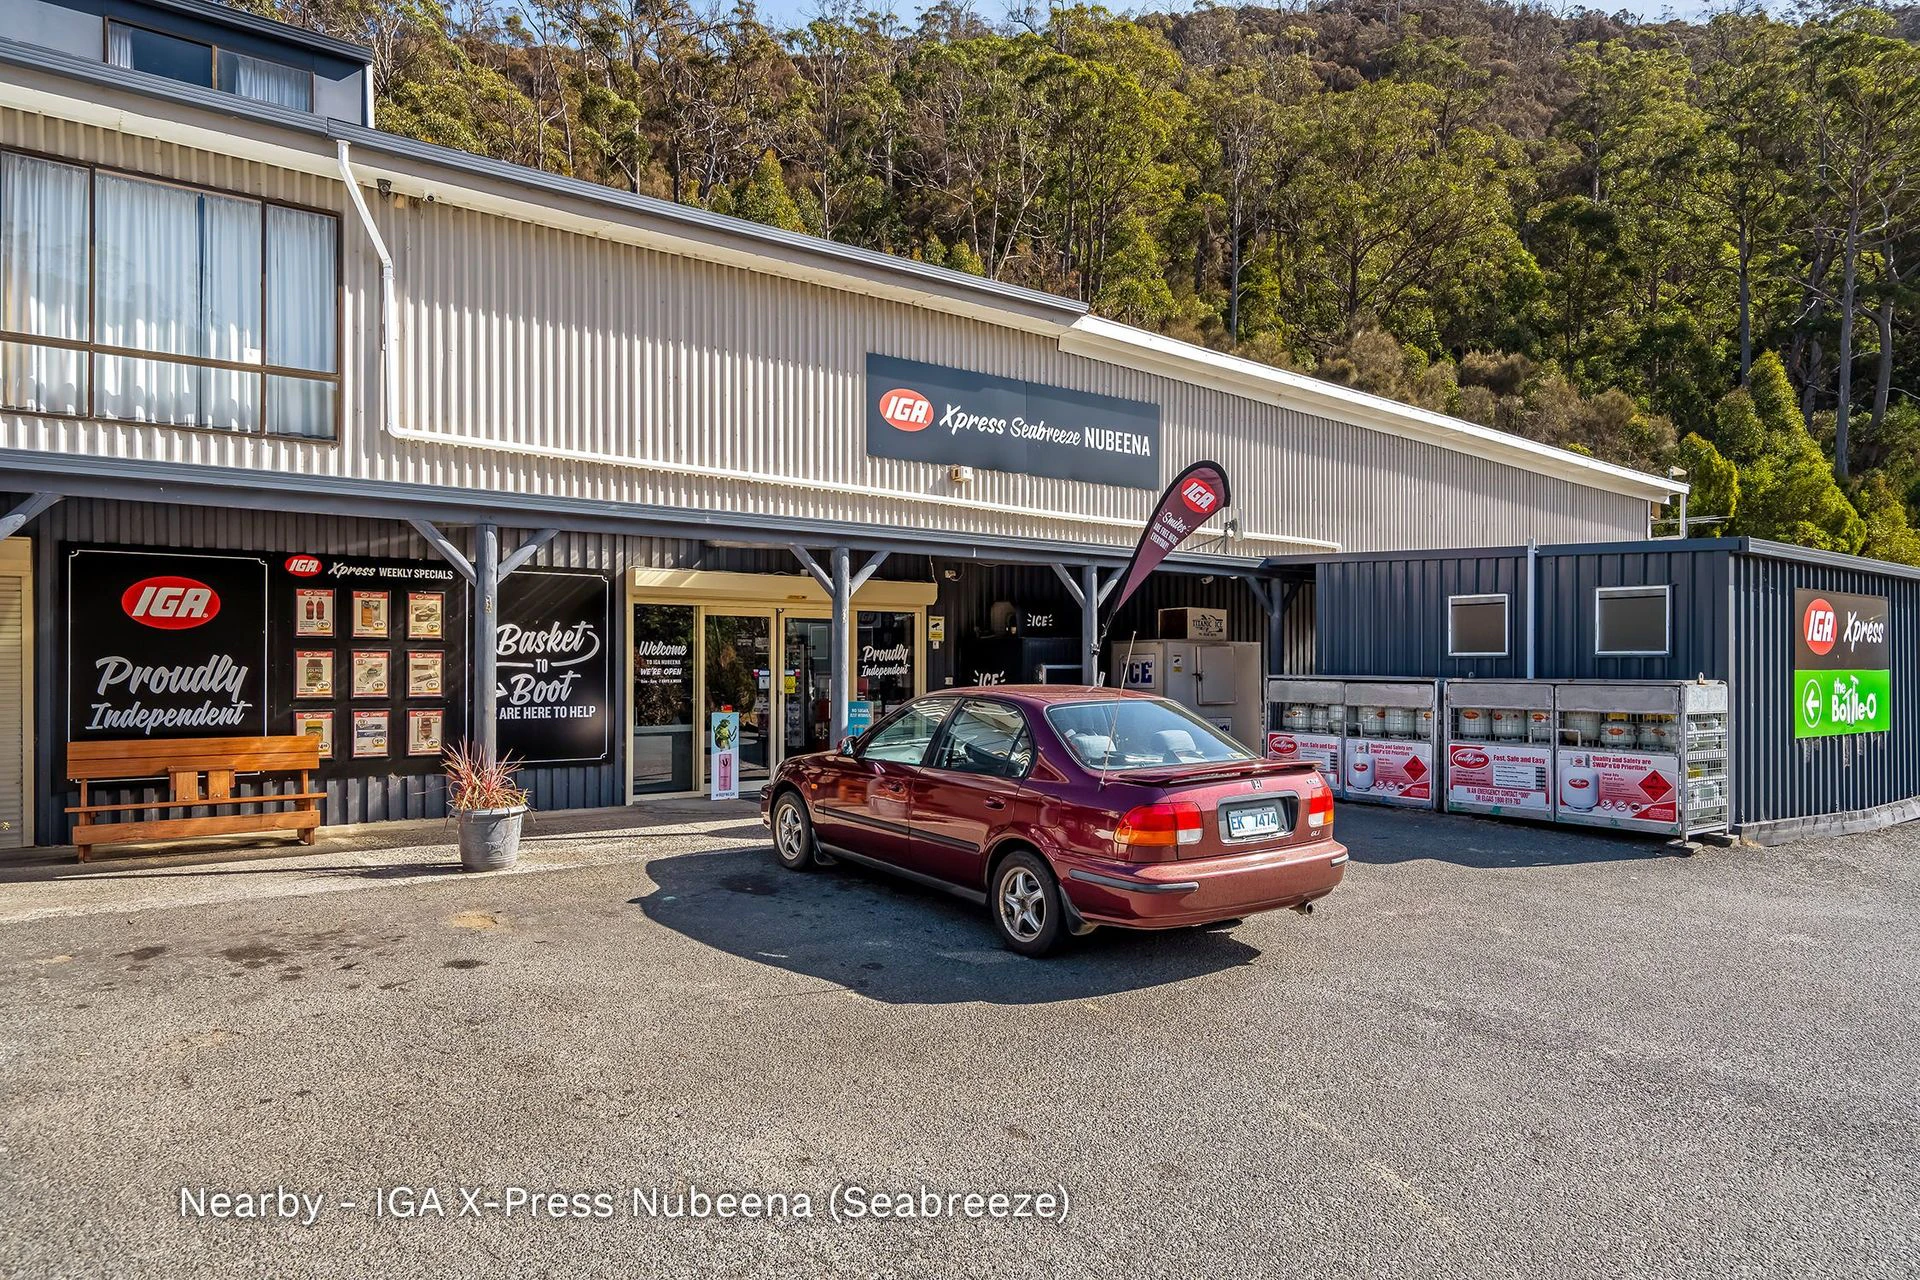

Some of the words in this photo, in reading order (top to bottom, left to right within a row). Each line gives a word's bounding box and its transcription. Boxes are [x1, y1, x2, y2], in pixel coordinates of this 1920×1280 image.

[885, 396, 928, 424] IGA
[939, 404, 1006, 436] Xpress
[1010, 417, 1082, 446] Seabreeze
[1085, 427, 1150, 456] NUBEENA
[1182, 482, 1215, 509] IGA
[1162, 512, 1187, 533] Smiles
[288, 559, 317, 572] IGA
[328, 562, 376, 578] Xpress
[379, 568, 412, 578] WEEKLY
[414, 569, 453, 580] SPECIALS
[132, 586, 212, 618] IGA
[1032, 615, 1048, 627] ICE
[1808, 610, 1834, 642] IGA
[1843, 611, 1884, 652] Xpress
[496, 621, 594, 656] Basket
[639, 641, 687, 656] Welcome
[863, 644, 909, 663] Proudly
[536, 659, 548, 673] TO
[861, 664, 910, 679] Independent
[96, 654, 248, 703] Proudly
[510, 670, 581, 705] Boot
[979, 673, 999, 686] ICE
[1834, 678, 1846, 694] the
[85, 700, 252, 735] Independent
[500, 707, 521, 719] ARE
[523, 706, 551, 719] HERE
[554, 706, 567, 718] TO
[570, 706, 596, 718] HELP
[1231, 815, 1245, 830] EK
